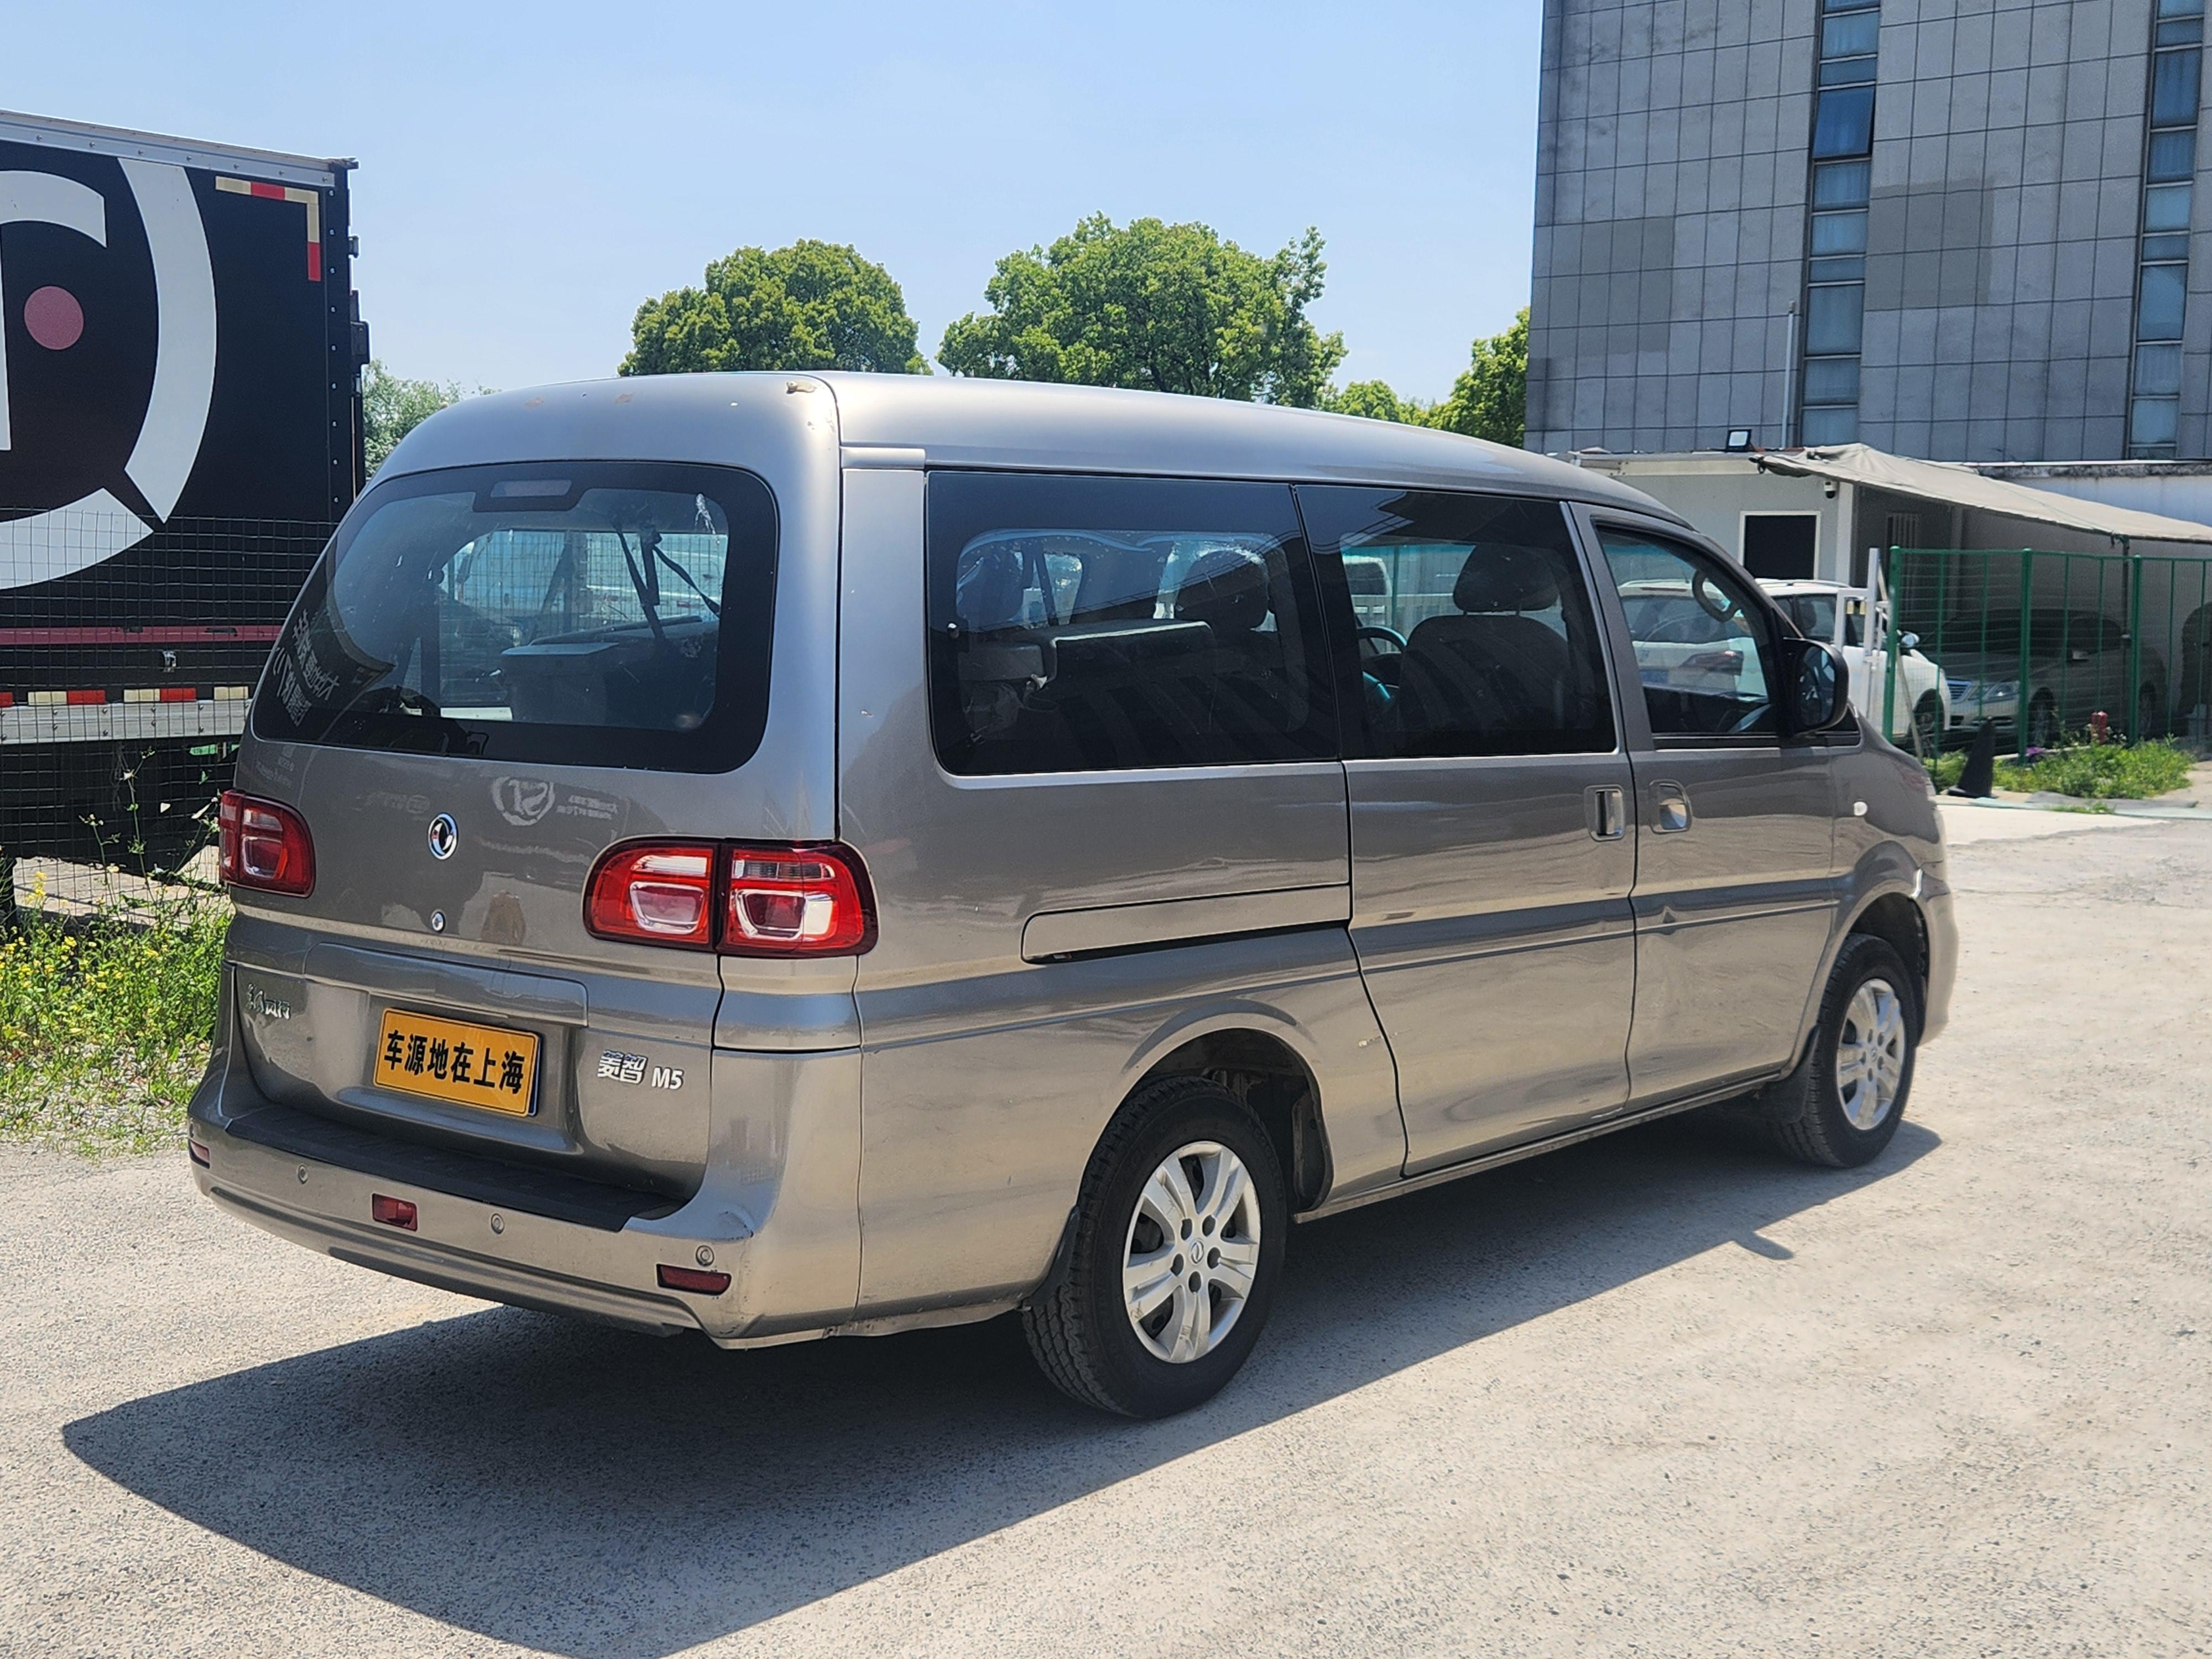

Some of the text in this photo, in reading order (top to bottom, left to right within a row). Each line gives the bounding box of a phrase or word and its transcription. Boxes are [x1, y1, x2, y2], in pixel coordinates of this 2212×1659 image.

[384, 1029, 525, 1095] 车源地在上海
[597, 1050, 684, 1090] 菱智 M5
